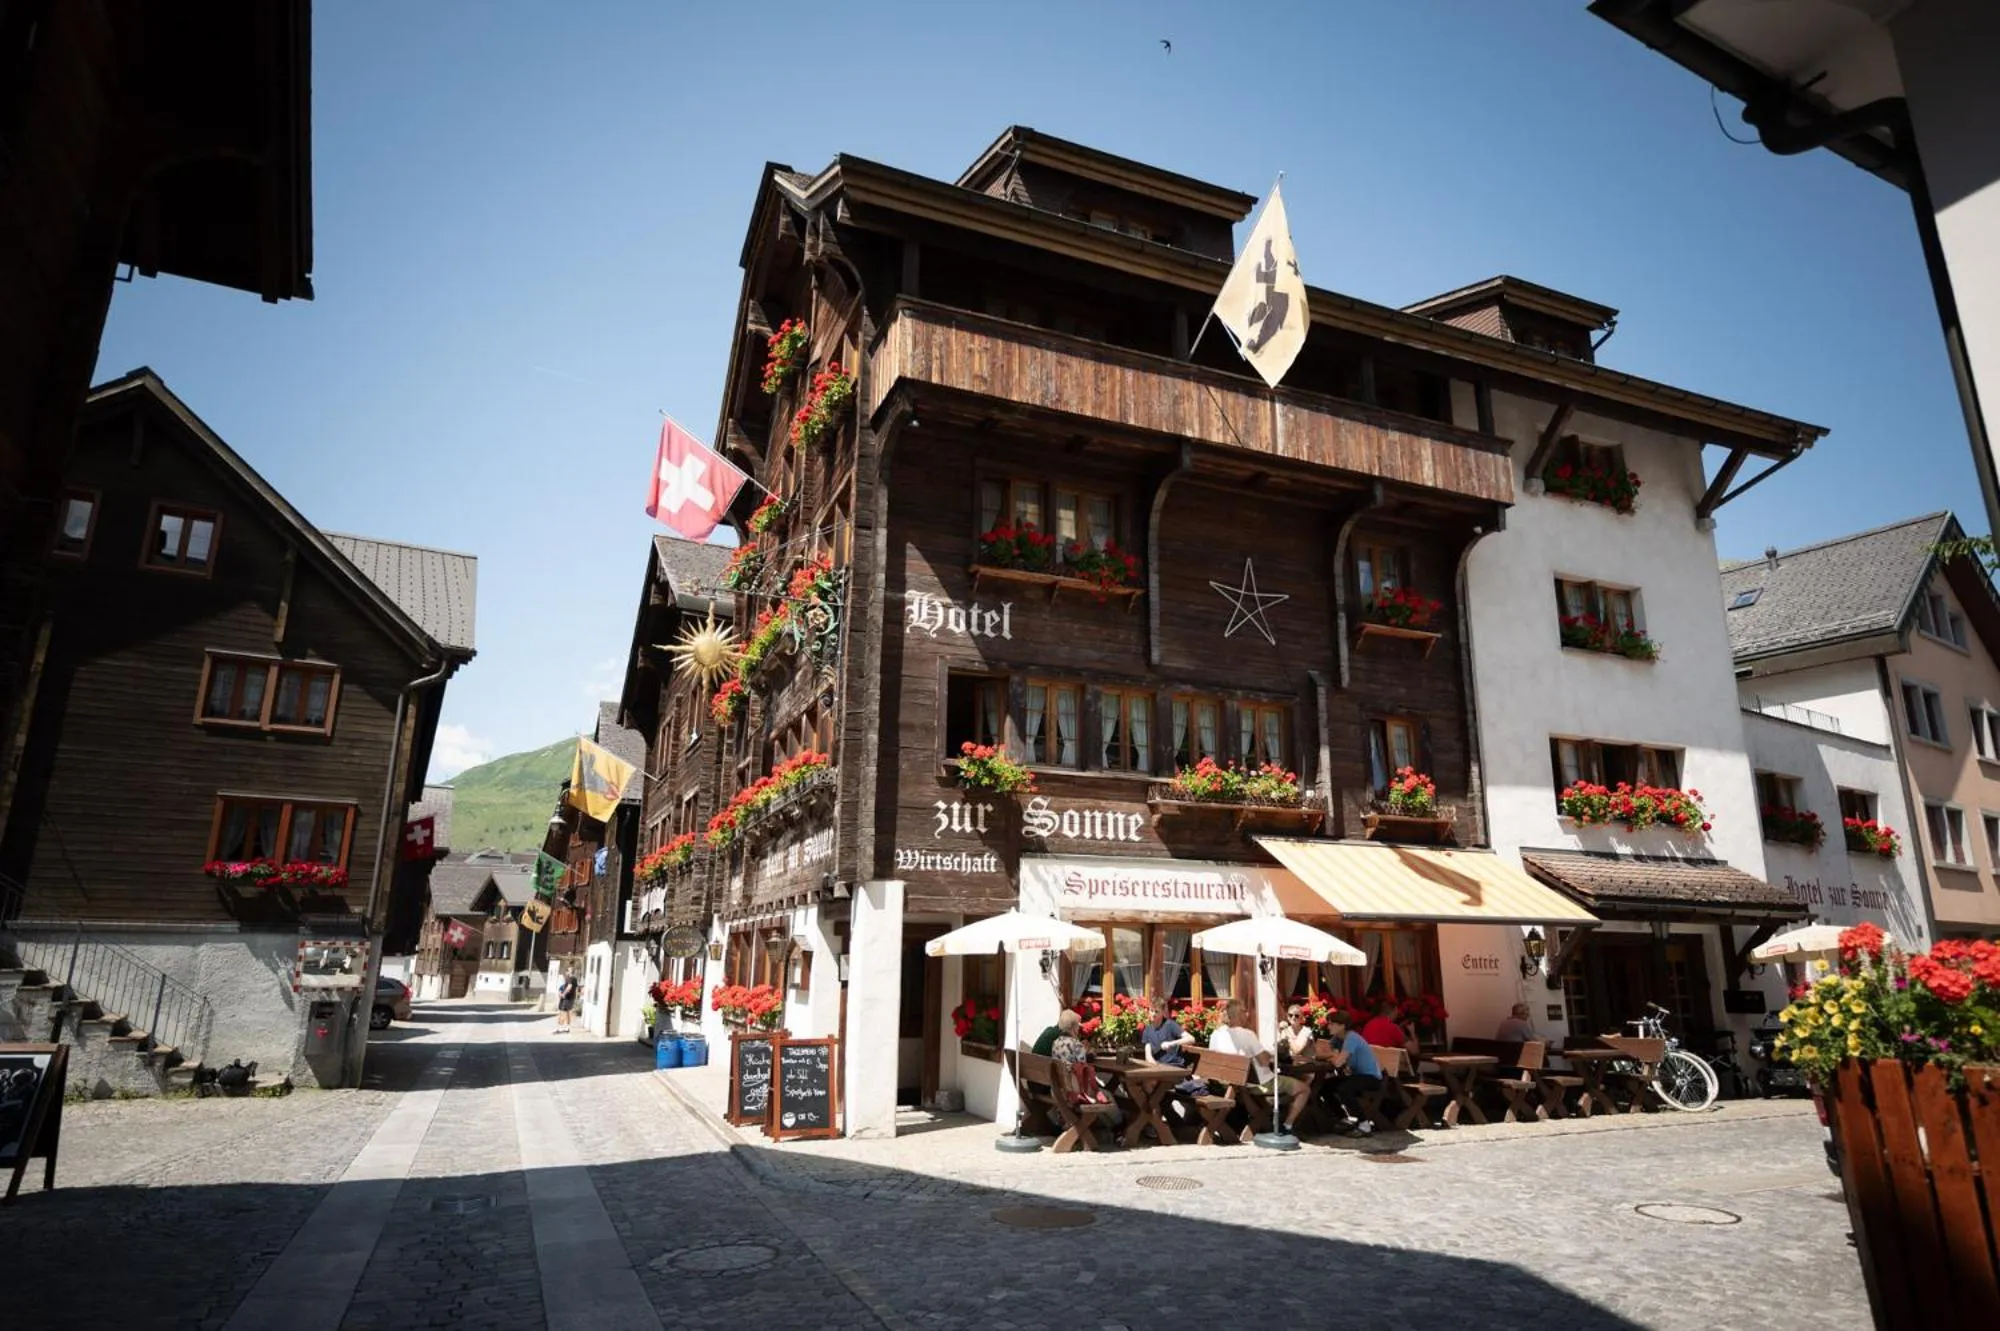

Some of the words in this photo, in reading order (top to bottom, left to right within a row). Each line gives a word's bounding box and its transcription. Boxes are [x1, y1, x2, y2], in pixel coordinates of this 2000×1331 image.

[904, 590, 1013, 640] Hotel
[933, 799, 994, 839] zur
[1021, 796, 1145, 842] Sonne
[896, 849, 998, 874] Wirtschaft
[1063, 871, 1247, 901] Speiserestaurant
[1783, 874, 1824, 905] Hotel
[1828, 883, 1847, 907] zur
